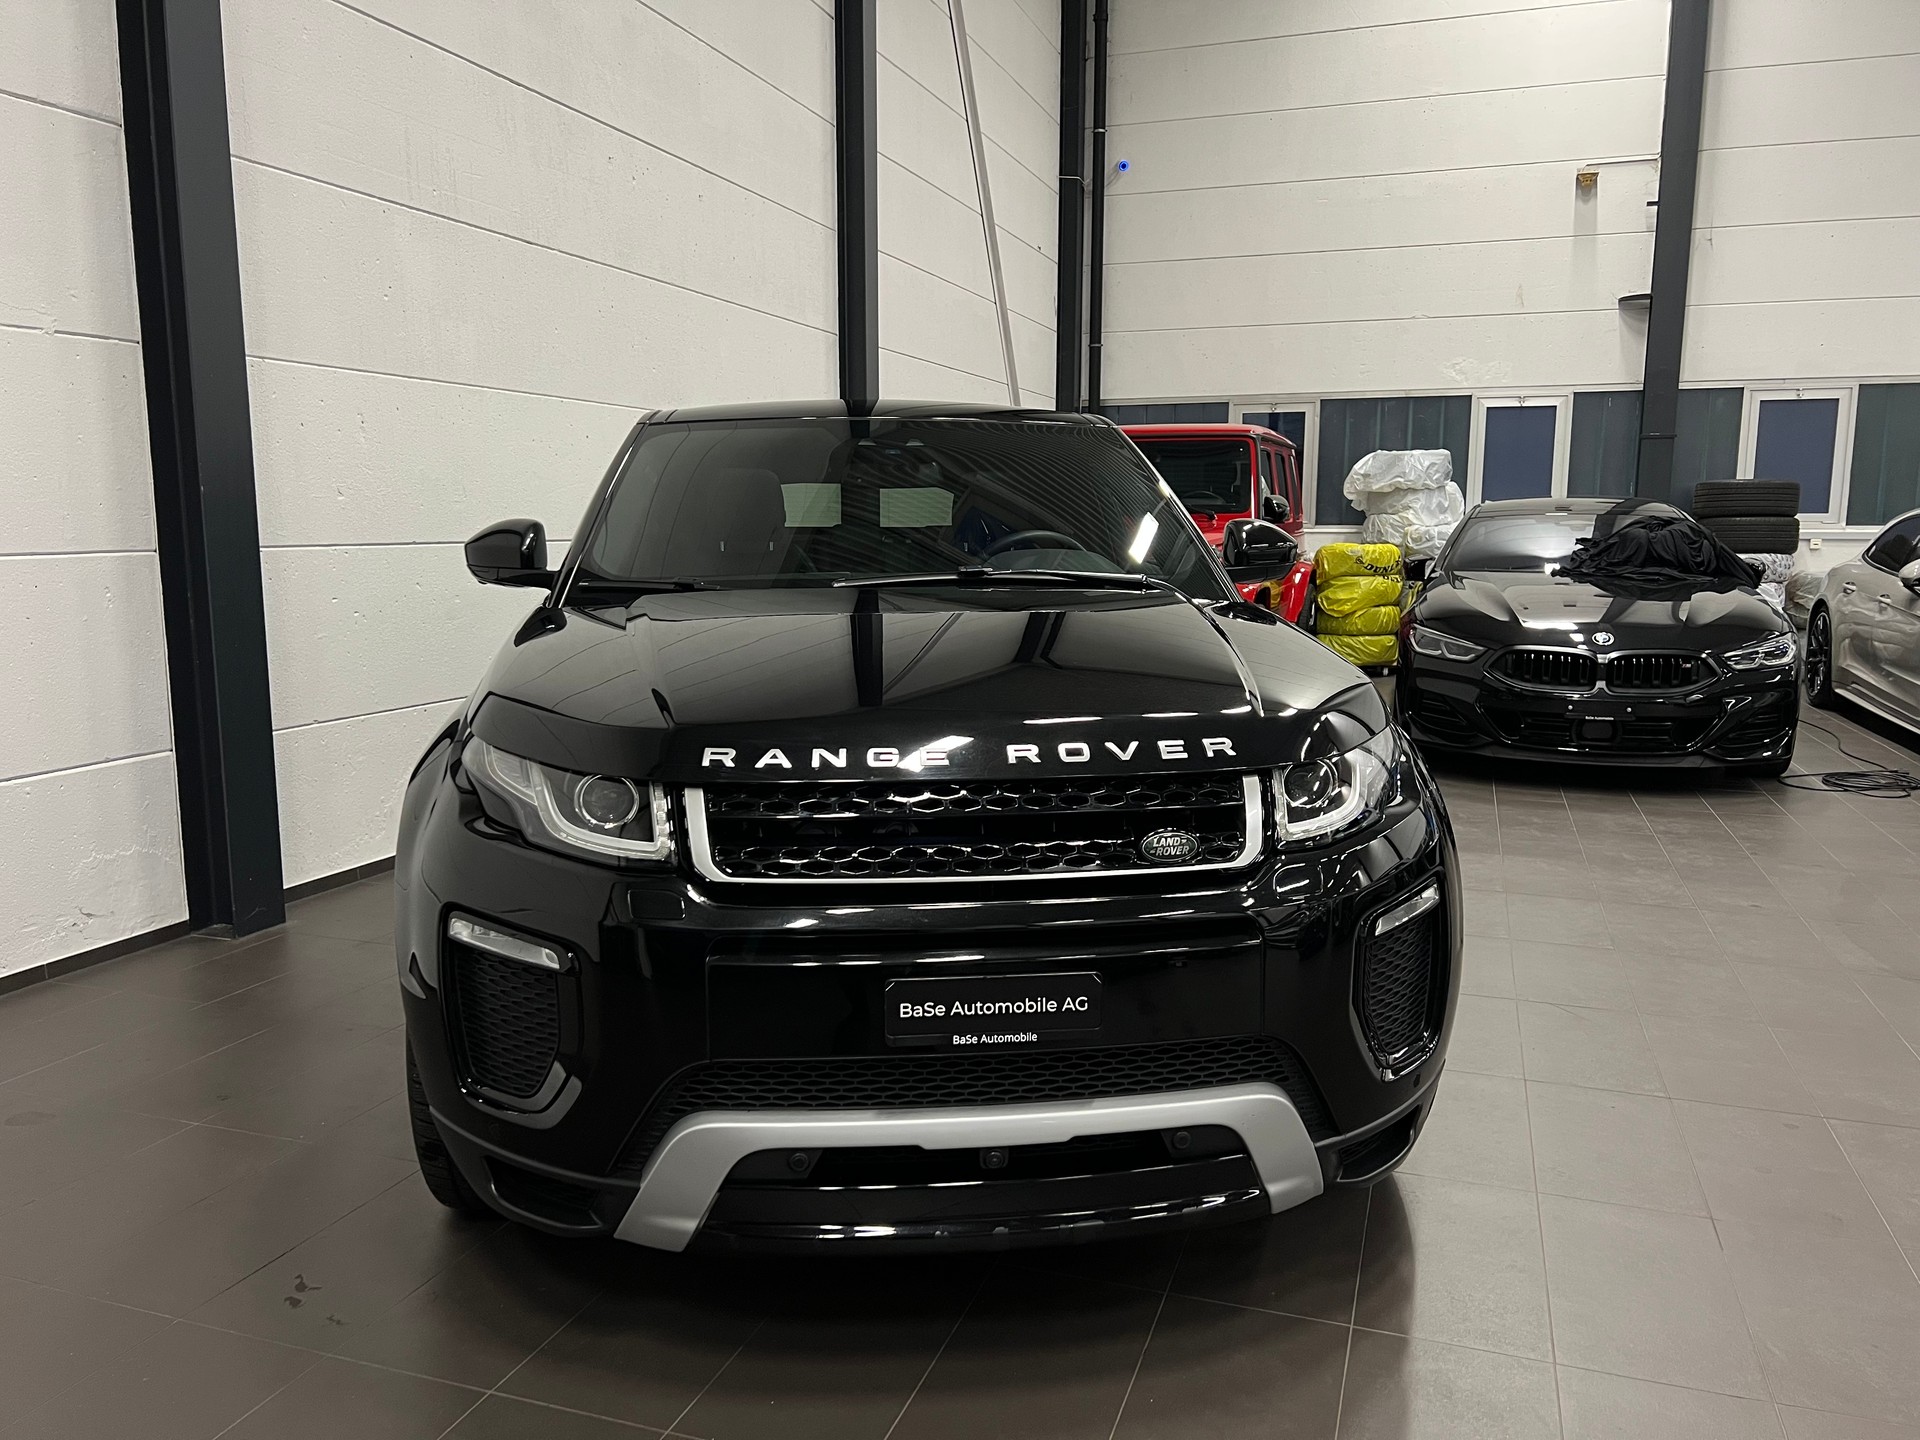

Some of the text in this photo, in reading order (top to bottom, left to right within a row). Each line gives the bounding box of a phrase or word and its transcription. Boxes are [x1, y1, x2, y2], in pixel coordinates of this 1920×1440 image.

[701, 737, 1237, 767] RANGE ROVER
[1152, 836, 1181, 847] LAND
[1155, 845, 1190, 856] ROVER
[899, 996, 1089, 1018] BaSe Automobile AG
[952, 1032, 1038, 1045] BaSe Automobile
